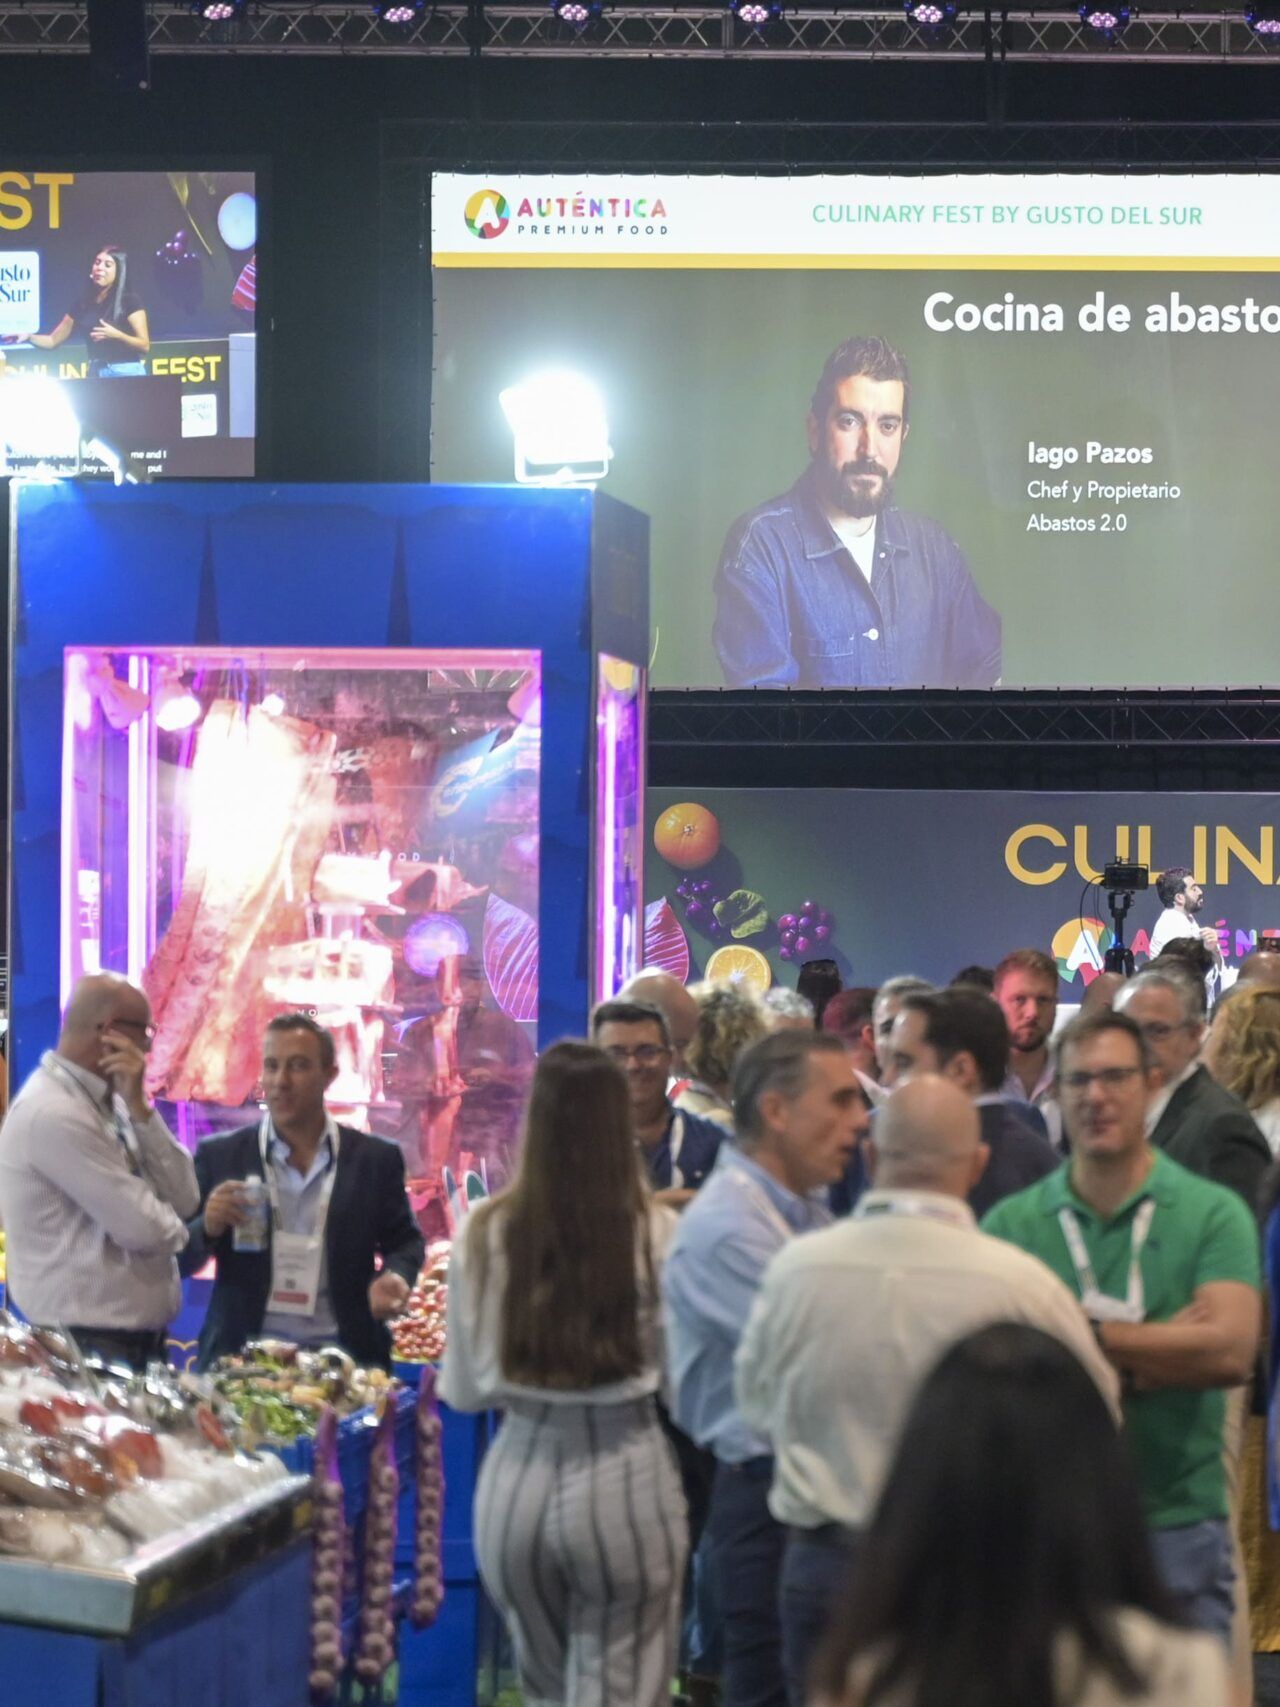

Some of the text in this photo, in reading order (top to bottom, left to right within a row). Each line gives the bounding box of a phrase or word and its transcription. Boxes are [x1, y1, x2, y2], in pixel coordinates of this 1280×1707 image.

[517, 191, 668, 219] AUTÉNTICA
[812, 204, 1203, 225] CULINARY FEST BY GUSTO DEL SUR
[517, 225, 669, 236] PREMIUM FOOD
[924, 292, 1065, 333] Cocina
[1078, 293, 1130, 333] de
[1028, 441, 1154, 470] Iago Pazos
[1027, 479, 1181, 505] Chef y Propietario
[1026, 513, 1128, 532] Abastos 2.0
